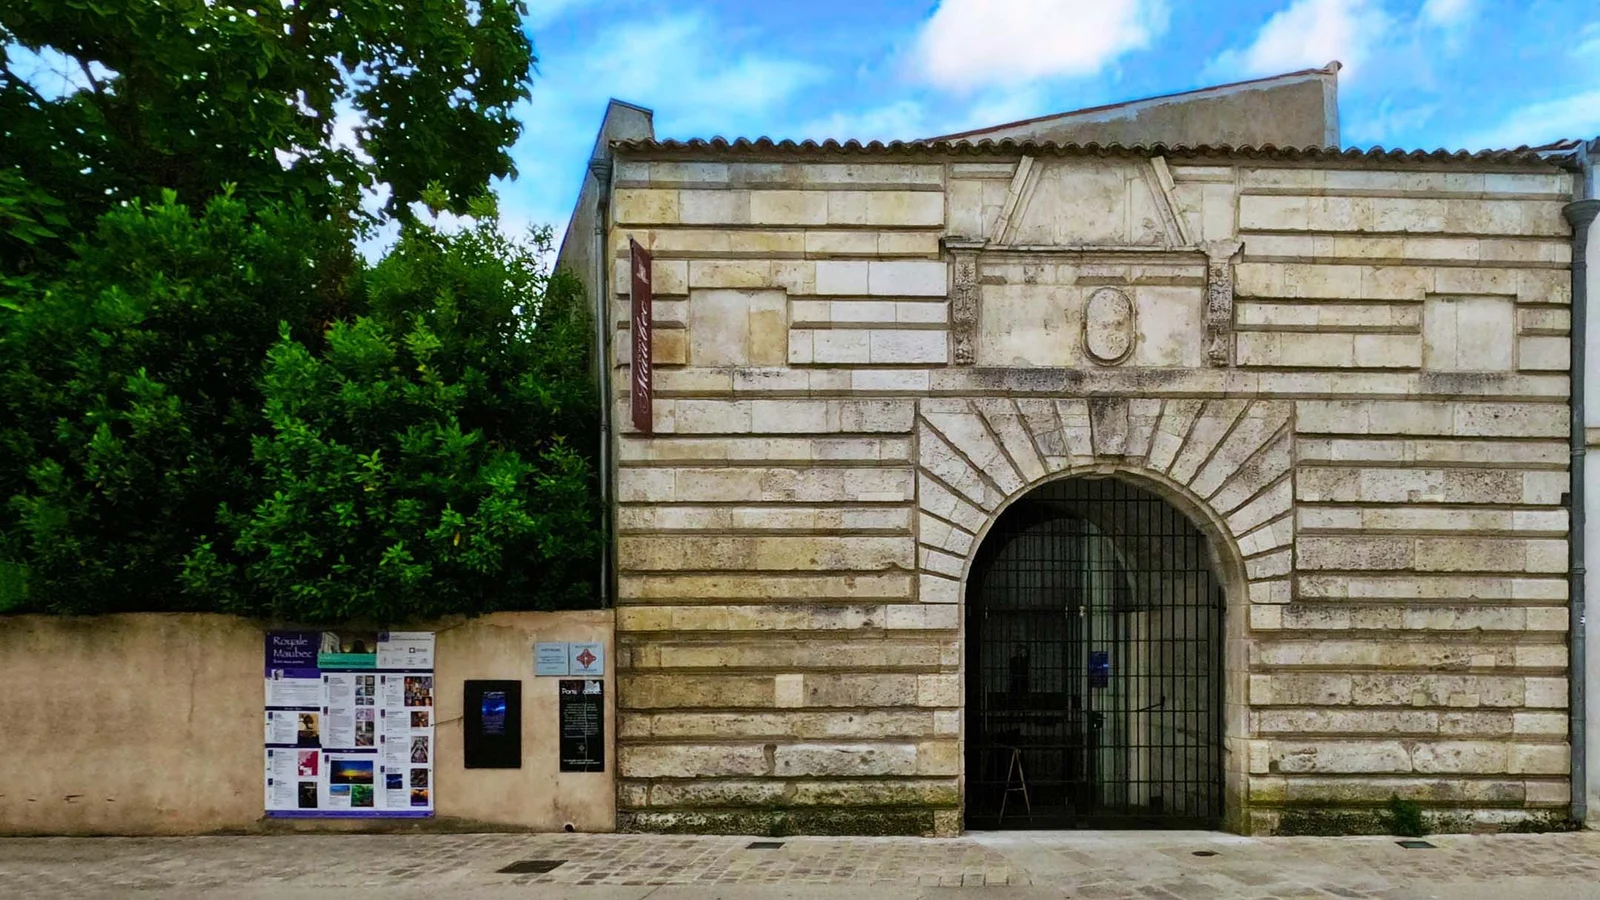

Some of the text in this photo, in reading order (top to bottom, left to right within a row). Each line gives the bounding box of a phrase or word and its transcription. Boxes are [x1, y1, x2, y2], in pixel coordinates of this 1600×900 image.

[637, 301, 649, 413] Maubec
[273, 634, 308, 649] Royale
[273, 646, 312, 658] Maubec
